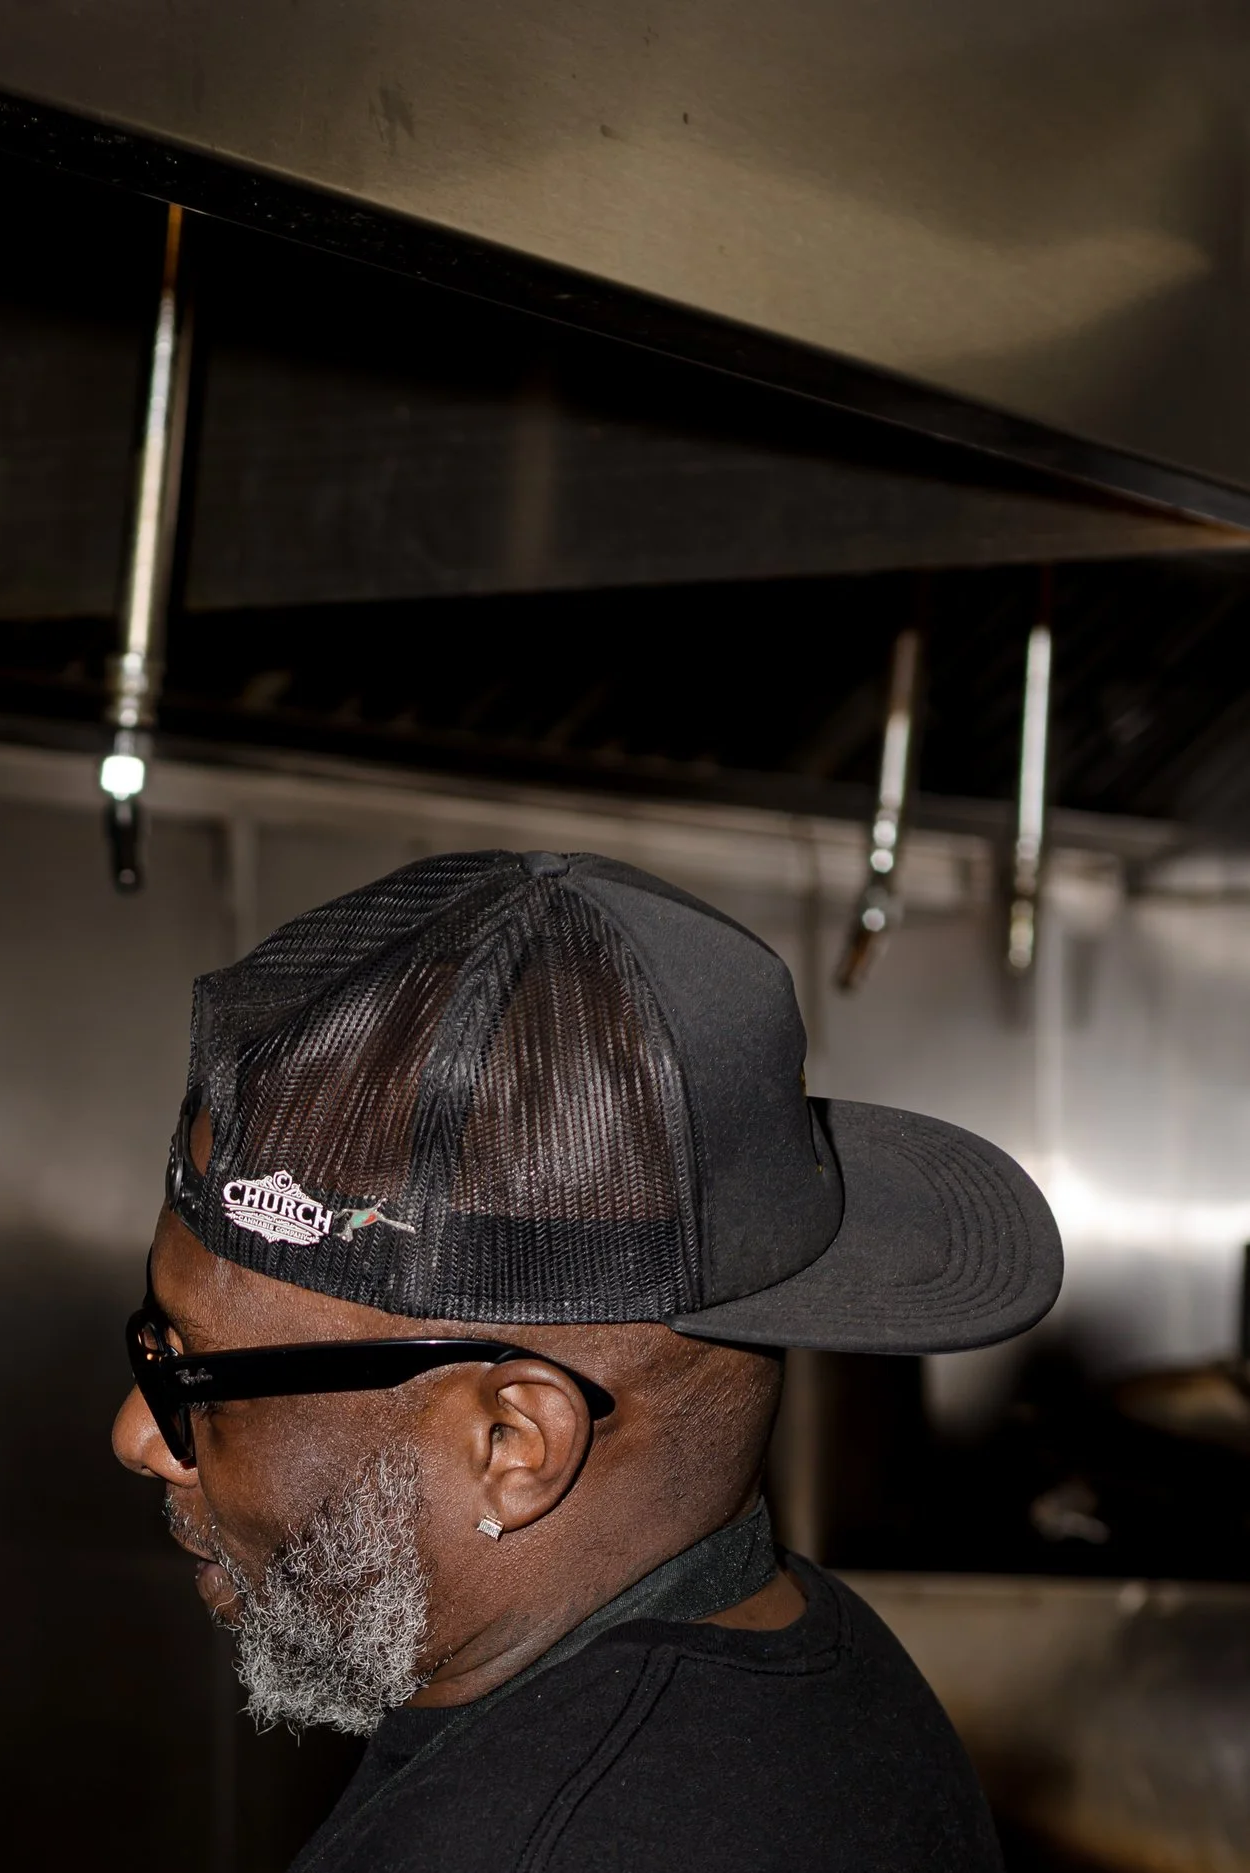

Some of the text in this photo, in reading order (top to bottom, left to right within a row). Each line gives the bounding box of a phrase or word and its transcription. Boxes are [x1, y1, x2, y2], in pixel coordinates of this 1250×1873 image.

[276, 1175, 289, 1188] C
[223, 1181, 333, 1234] CHURCH
[238, 1216, 308, 1241] CANNABIS COMPANY
